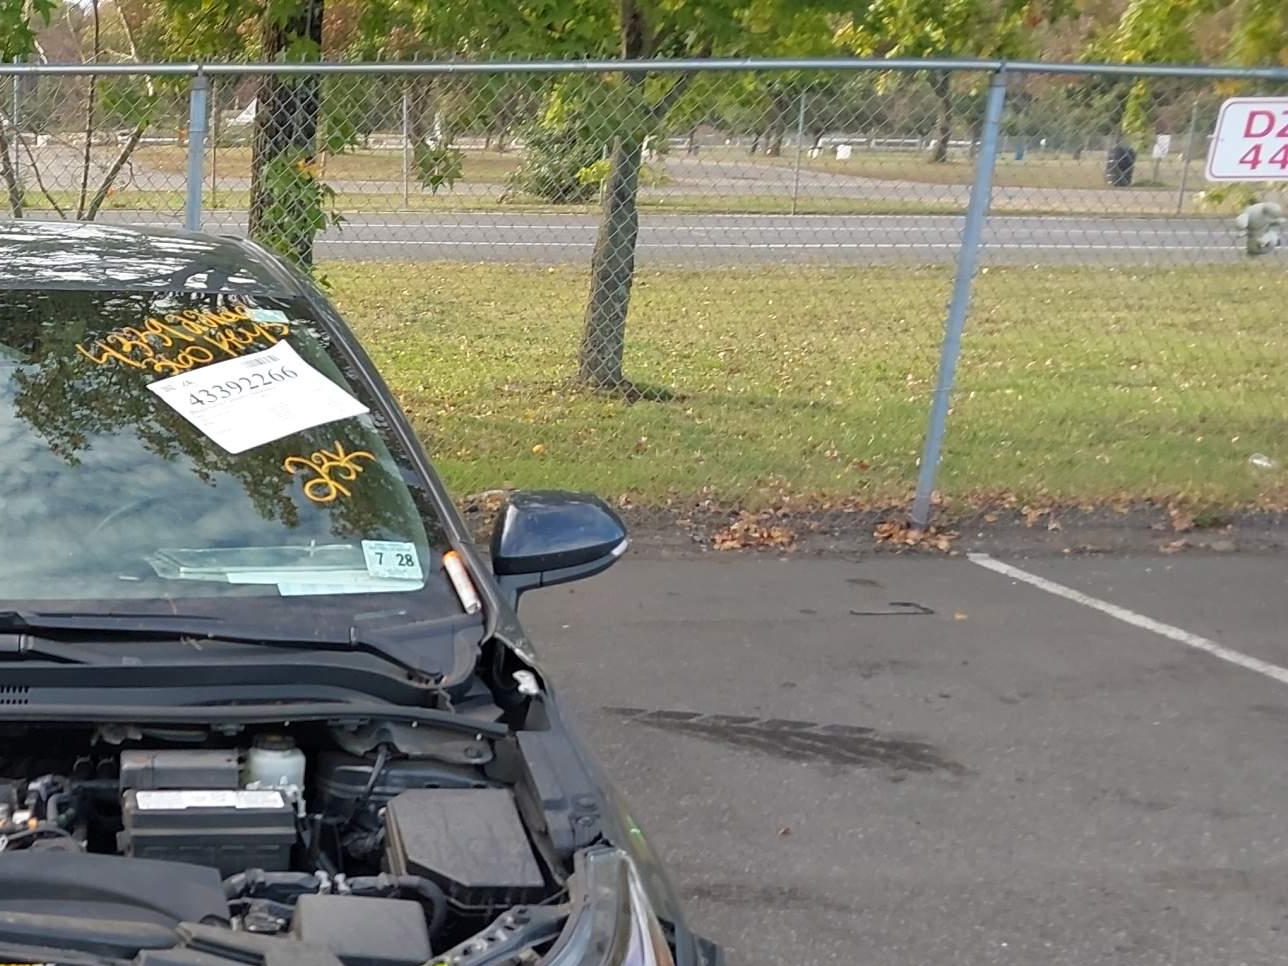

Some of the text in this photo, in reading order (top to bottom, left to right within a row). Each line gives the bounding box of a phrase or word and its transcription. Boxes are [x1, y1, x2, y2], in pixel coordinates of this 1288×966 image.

[1239, 143, 1288, 170] 44
[188, 364, 299, 407] 43392266
[374, 551, 415, 567] 7 28
